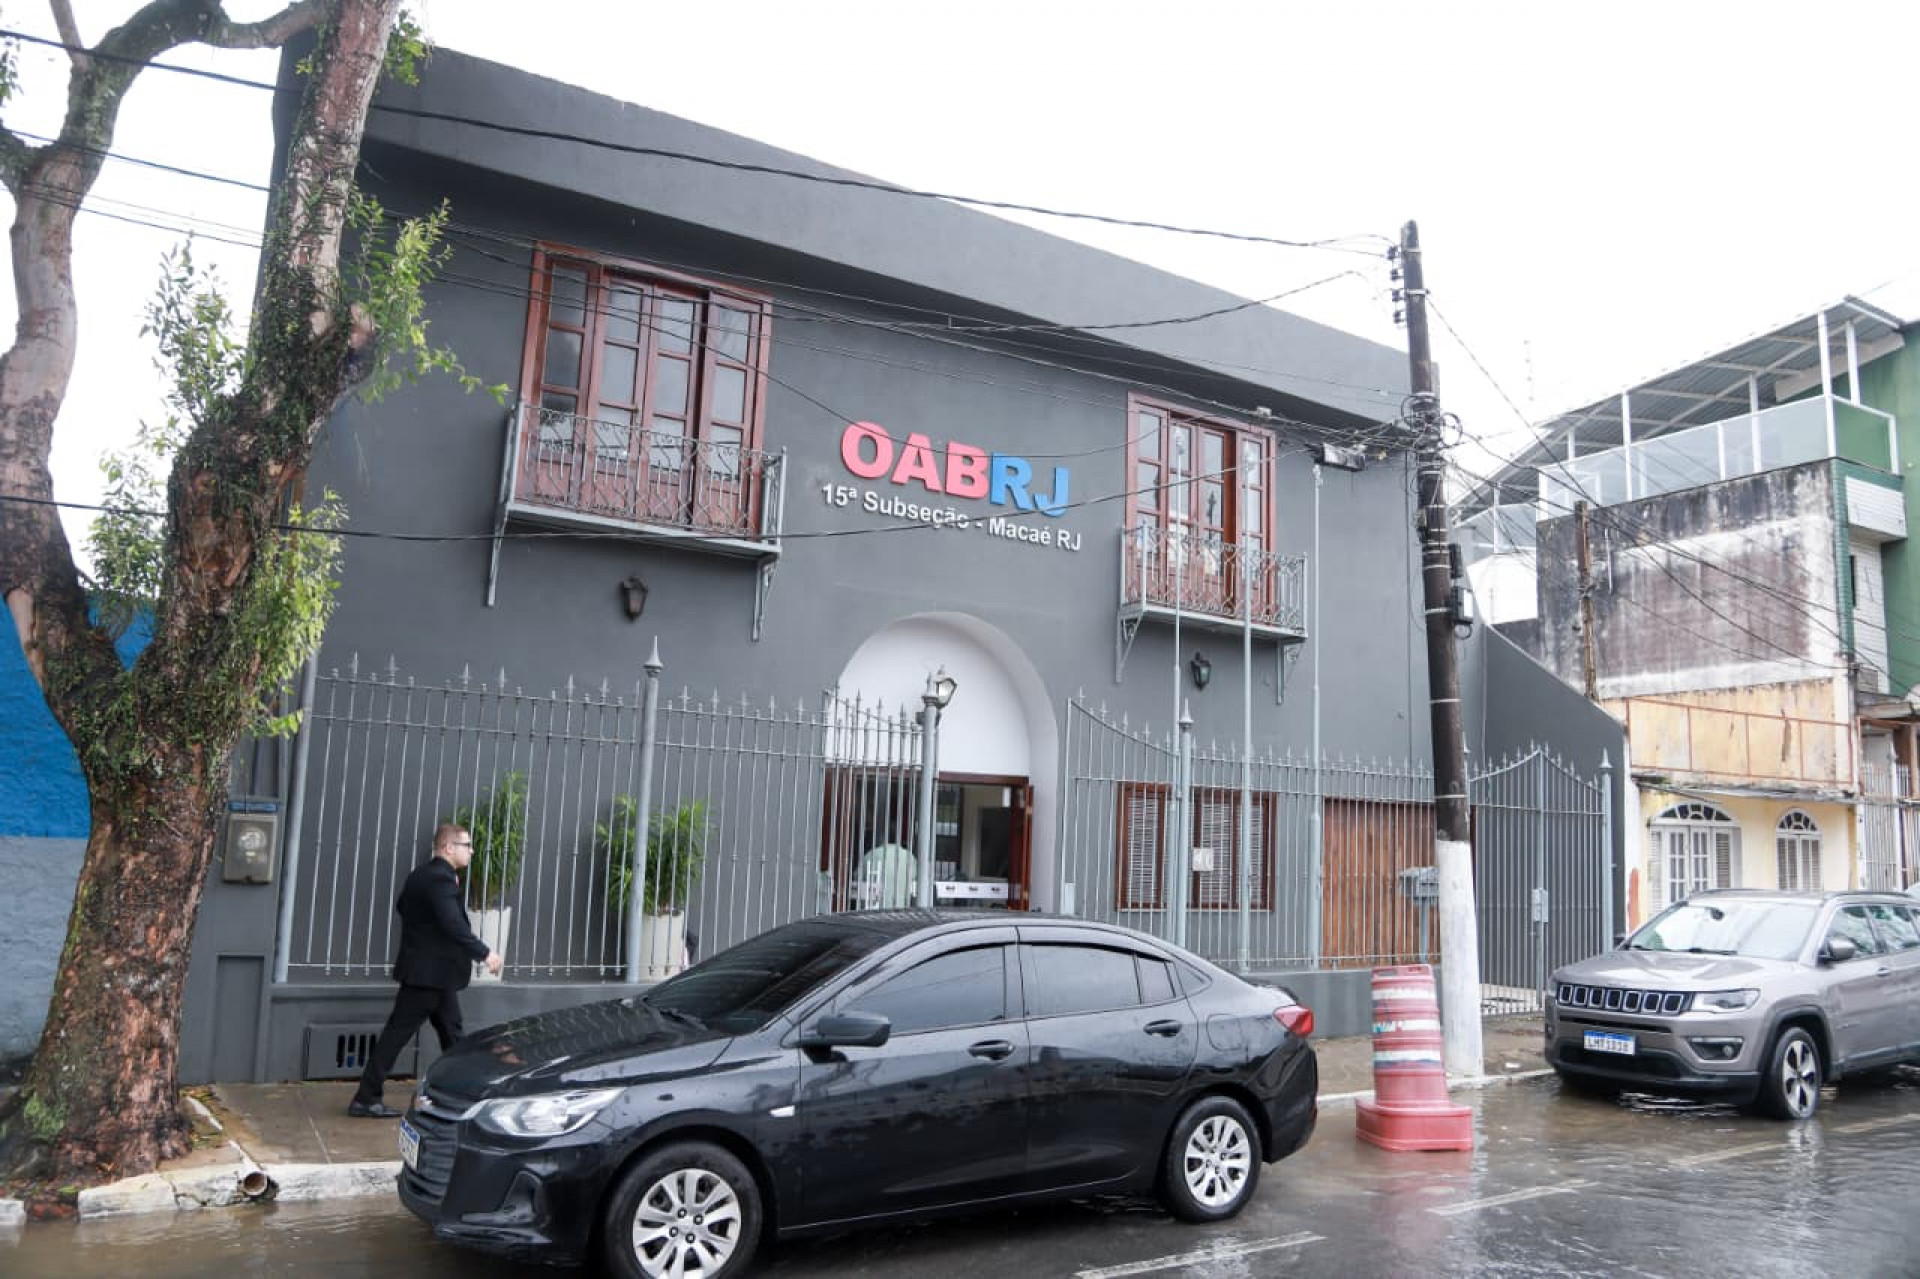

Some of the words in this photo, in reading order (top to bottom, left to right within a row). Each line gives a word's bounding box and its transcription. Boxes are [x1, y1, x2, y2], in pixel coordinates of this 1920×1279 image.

[863, 491, 970, 530] Subseção
[988, 517, 1052, 546] Macaé
[1057, 528, 1082, 551] RJ
